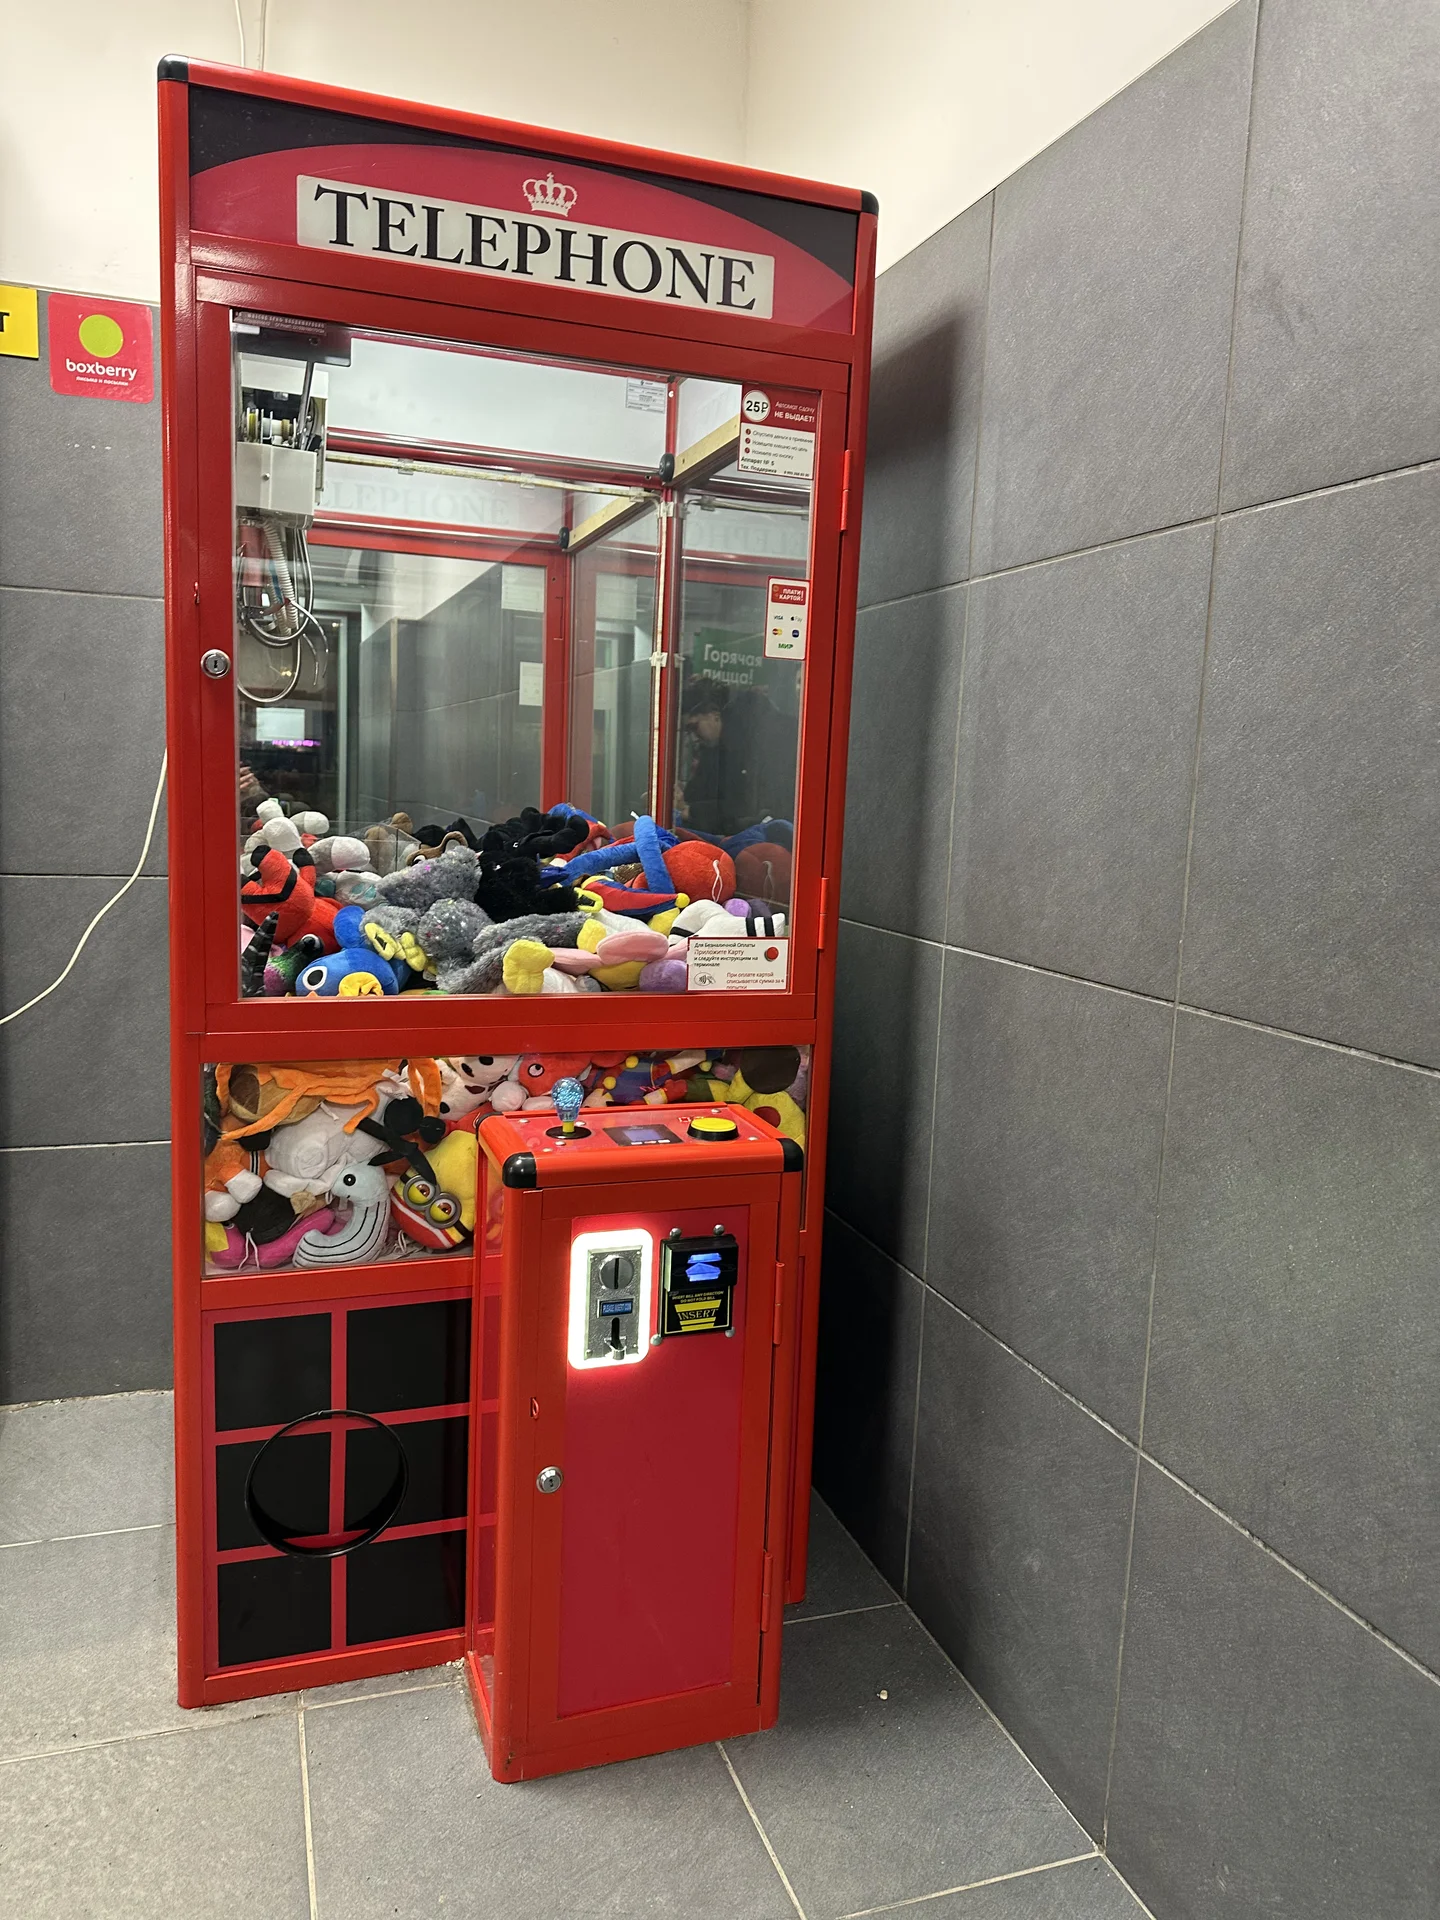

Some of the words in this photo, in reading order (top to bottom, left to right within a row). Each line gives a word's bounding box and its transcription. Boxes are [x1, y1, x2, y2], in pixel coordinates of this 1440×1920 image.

[314, 183, 757, 311] TELEPHONE
[65, 358, 138, 381] boxberry
[774, 411, 784, 419] НЕ
[784, 412, 815, 423] ВЫДАЕТ!
[703, 643, 763, 668] Горячая
[677, 1308, 719, 1321] INSERT
